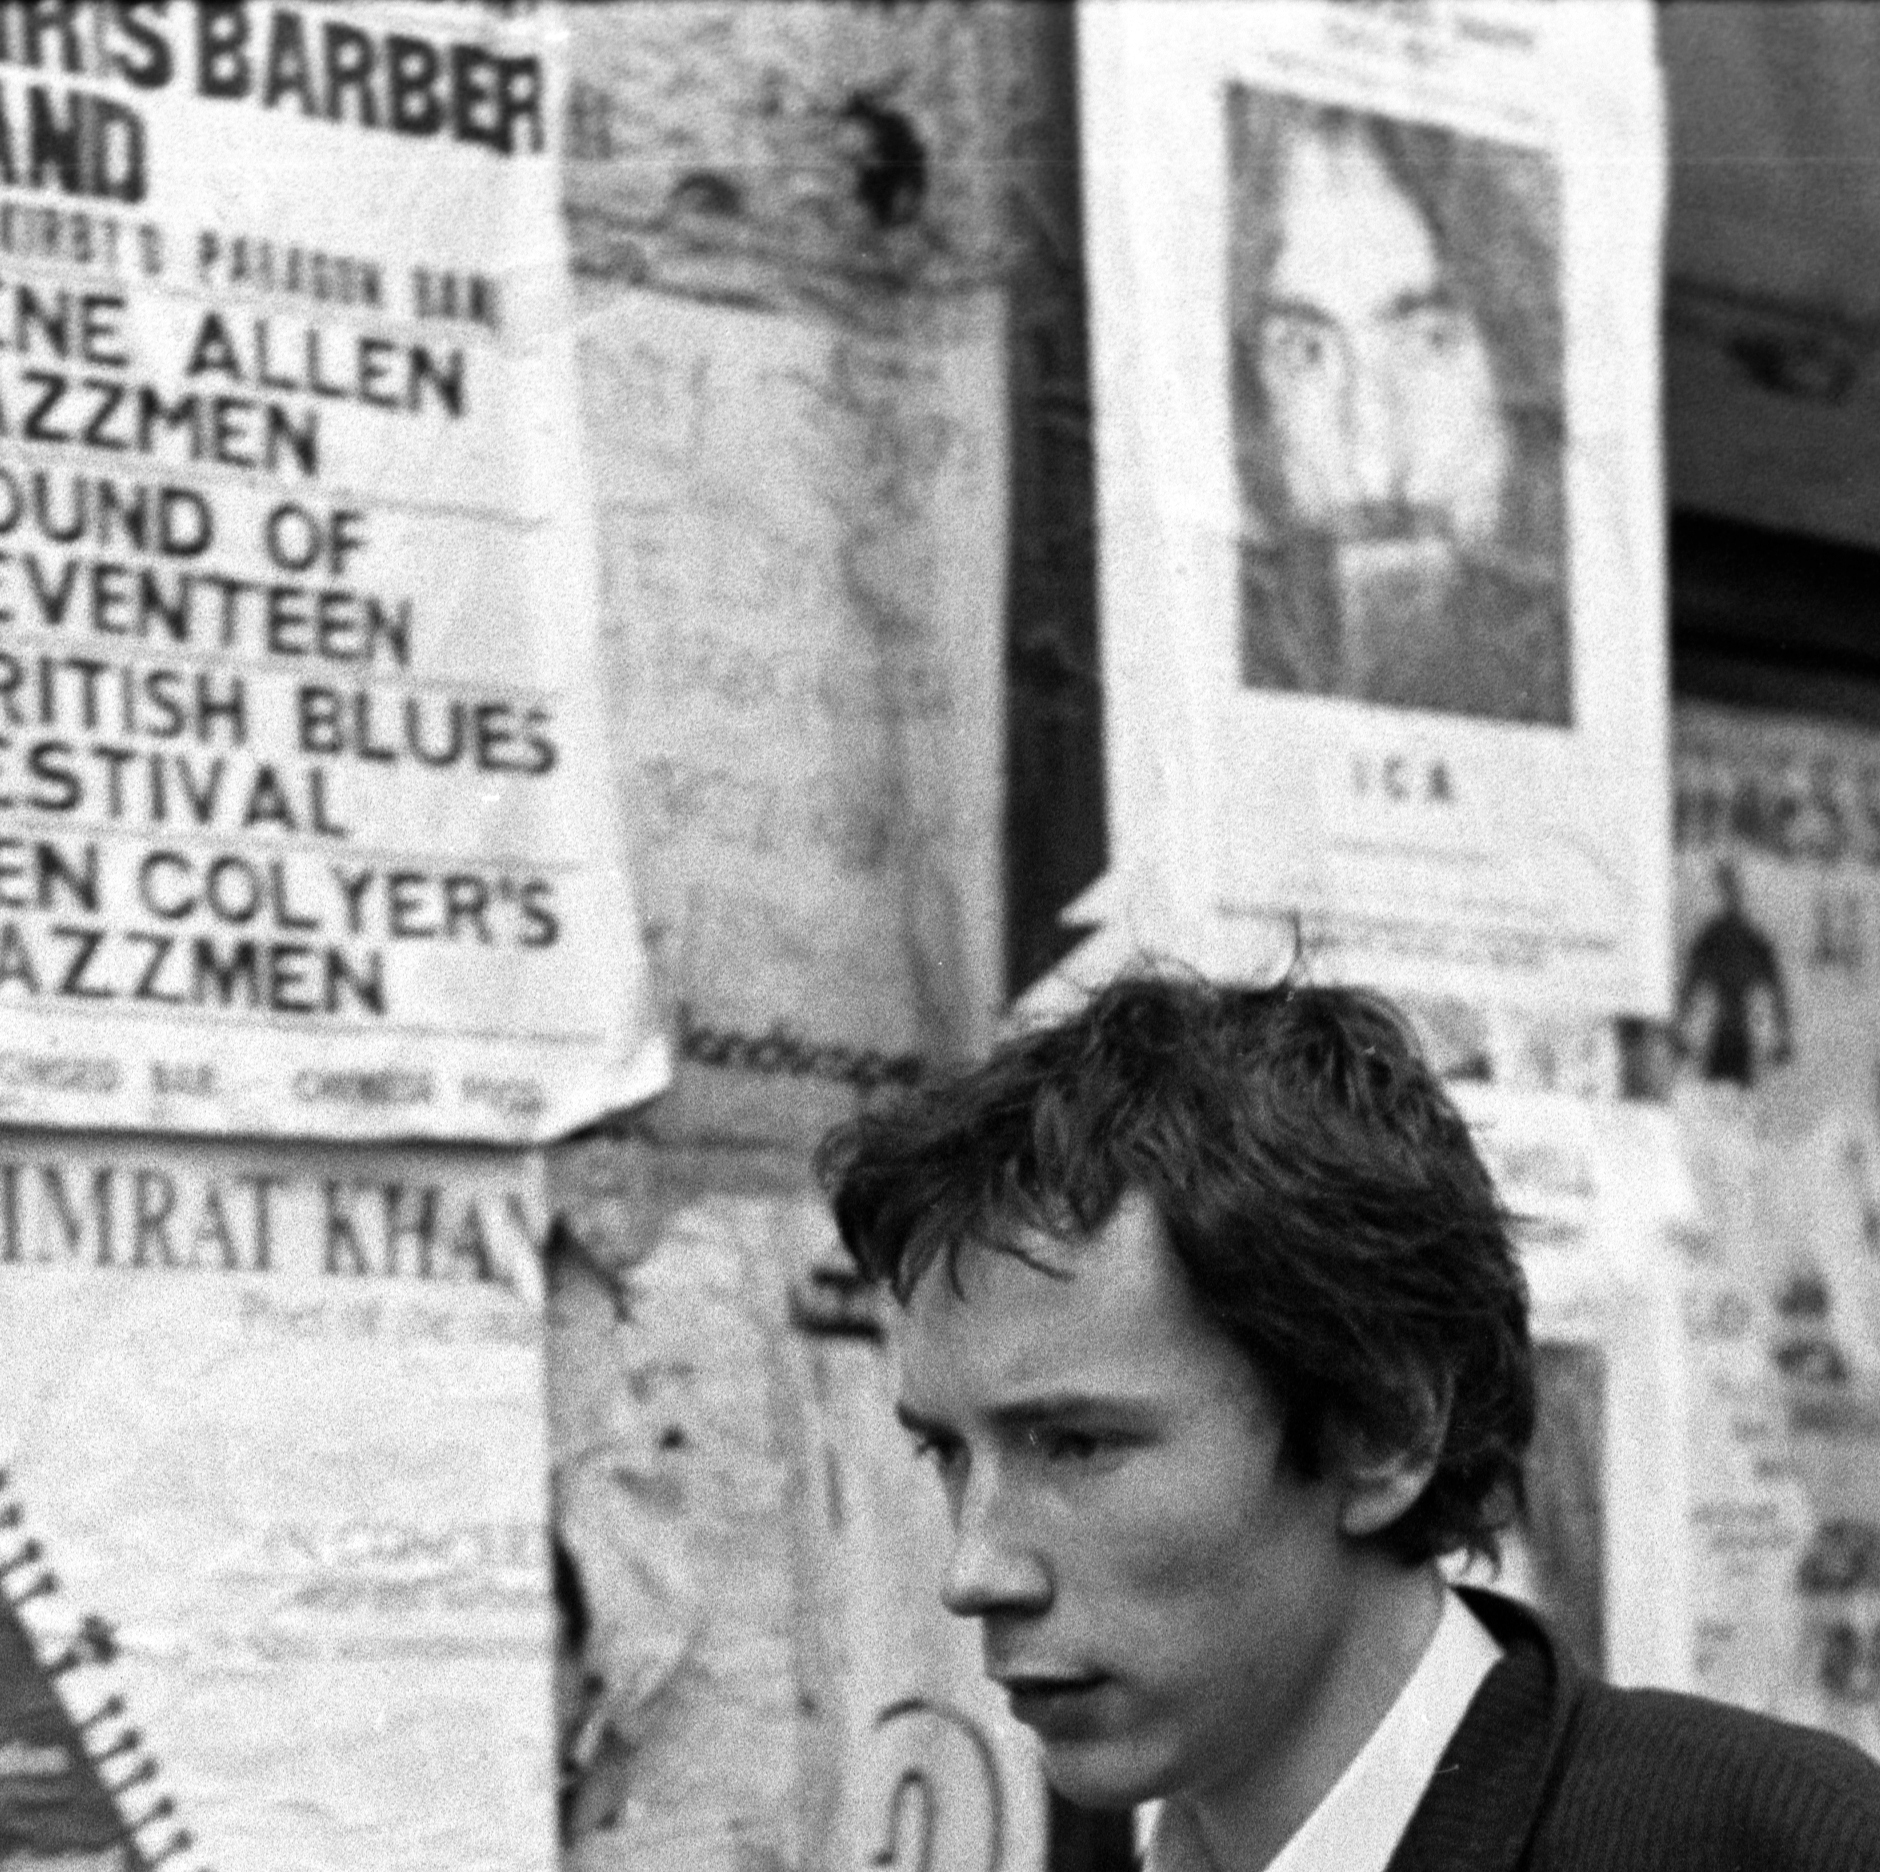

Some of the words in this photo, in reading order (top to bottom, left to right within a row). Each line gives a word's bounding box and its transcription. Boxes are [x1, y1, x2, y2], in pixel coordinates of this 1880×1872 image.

[194, 0, 546, 156] BARBER
[187, 311, 469, 421] ALLEN
[266, 503, 369, 577] OF
[297, 686, 558, 779] BLUES
[137, 846, 562, 952] COLYER'S
